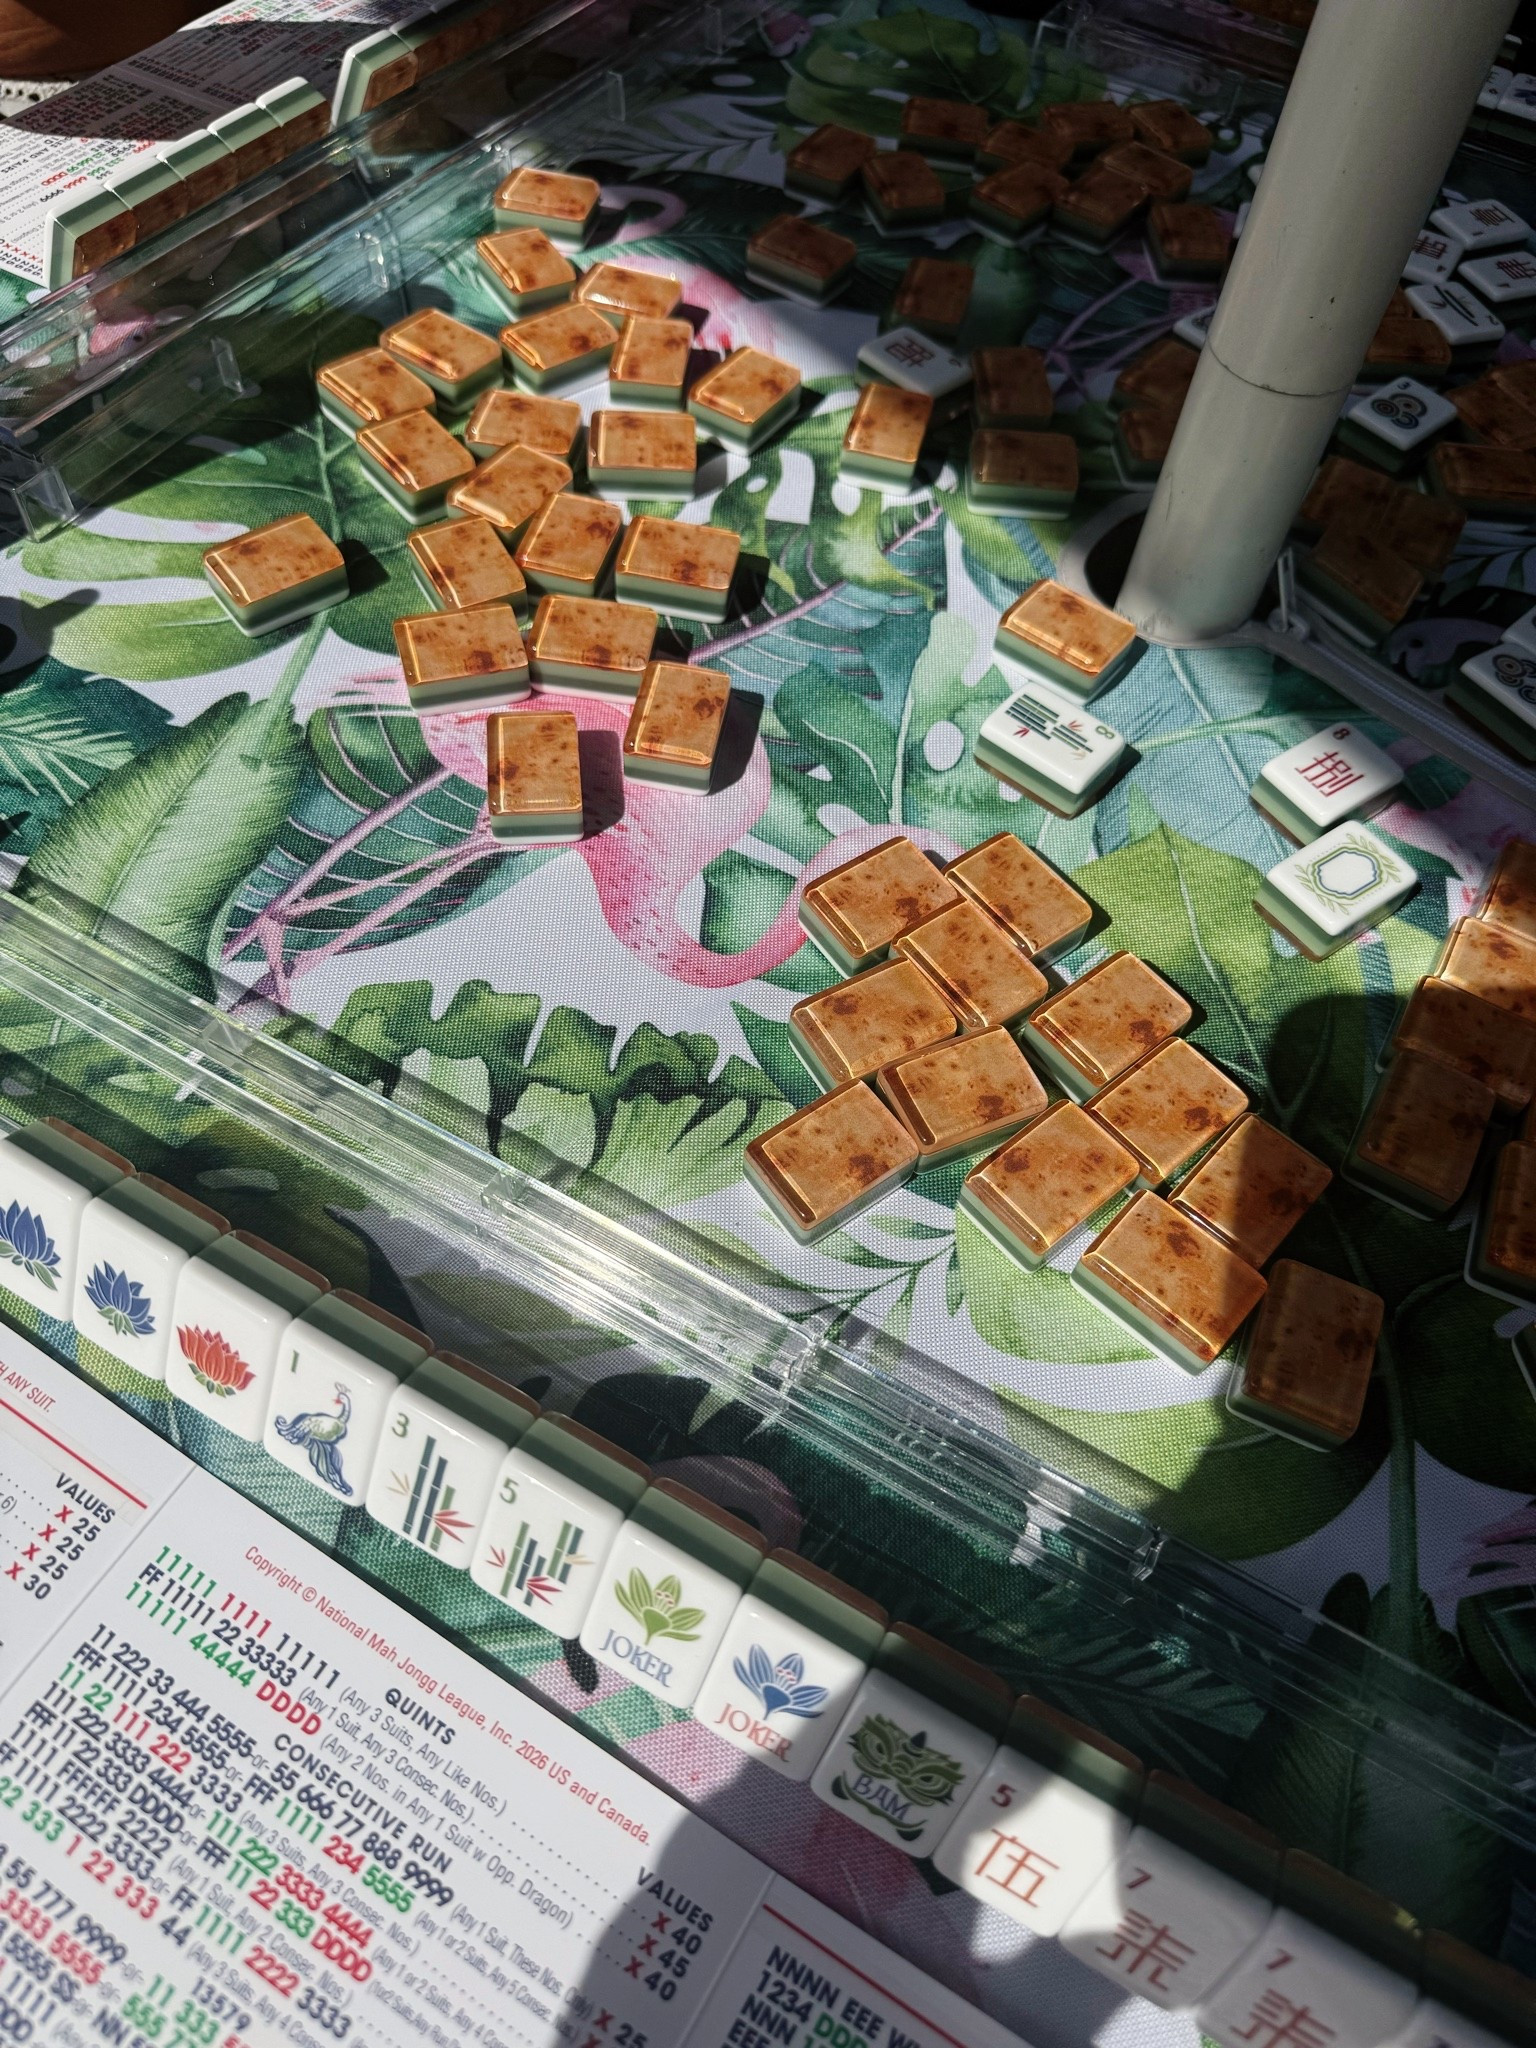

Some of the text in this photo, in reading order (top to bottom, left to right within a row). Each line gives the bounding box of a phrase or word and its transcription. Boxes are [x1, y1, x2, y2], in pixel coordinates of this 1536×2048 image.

[1094, 724, 1116, 741] 8
[1331, 727, 1352, 742] 8
[3, 1371, 57, 1413] ANY SUIT.
[391, 1411, 411, 1439] 3
[55, 1472, 116, 1524] VALUES
[499, 1476, 521, 1505] 5
[37, 1523, 58, 1543] X
[55, 1535, 85, 1562] 25
[54, 1504, 101, 1542] X 25
[4, 1561, 52, 1600] X 30
[21, 1542, 69, 1581] X 25
[599, 1628, 674, 1689] JOKER
[245, 1546, 303, 1595] Copyright
[314, 1595, 371, 1641] National
[366, 1632, 398, 1663] Mah
[396, 1656, 439, 1695] Jongg
[437, 1683, 486, 1731] League,
[488, 1720, 513, 1748] Inc.
[515, 1739, 550, 1770] 2026
[547, 1761, 572, 1786] US
[569, 1781, 599, 1806] and
[597, 1797, 649, 1846] Canada.
[384, 1687, 456, 1745] QUINTS
[58, 1661, 86, 1690] 11
[82, 1682, 114, 1713] 22
[112, 1702, 152, 1741] 111
[148, 1734, 192, 1775] 222
[189, 1764, 244, 1814] 3333
[155, 1545, 703, 1956] 11111 1111 11111 (Any 3 Suits, Any Like Nos.) X 40
[713, 1702, 795, 1763] JOKER
[10, 1719, 172, 1861] 1111 FFFFFF 2222
[14, 1756, 61, 1804] 1111
[56, 1794, 109, 1844] 2222
[72, 1641, 416, 1914] FFF 1111 234 1111 234 5555
[125, 1581, 677, 2002] 11111 44444 DDDD (Any 2 Nos. in Any 1 Suit w Opp. Dragon) X 40
[138, 1562, 690, 1979] FF 11111 22 33333 (Any 1 Suit, Any 3 Consec. Nos.) X 45
[852, 1773, 914, 1822] BAM
[990, 1783, 1018, 1808] 5
[42, 1680, 374, 1950] 111 222 3333 222 3333 4444
[274, 1733, 453, 1874] CONSECUTIVE RUN
[24, 1699, 373, 1983] FFF 11 22 333 11 22 333 DDDD
[90, 1623, 117, 1651] 11
[111, 1642, 151, 1679] 222
[146, 1667, 175, 1696] 33
[170, 1689, 211, 1724] 444
[296, 1783, 337, 1821] 666
[333, 1809, 366, 1839] 77
[361, 1831, 403, 1871] 888
[401, 1860, 455, 1908] 9999
[592, 2008, 615, 2033] X
[613, 2022, 648, 2048] 25
[21, 1800, 192, 1947] 333 1 22 333 44
[637, 1866, 714, 1933] VALUES
[1126, 1866, 1152, 1890] 7
[1266, 1947, 1295, 1972] 7
[740, 1993, 798, 2047] NNN
[756, 1969, 815, 2024] 1234
[766, 1945, 885, 2041] NNNN EEE
